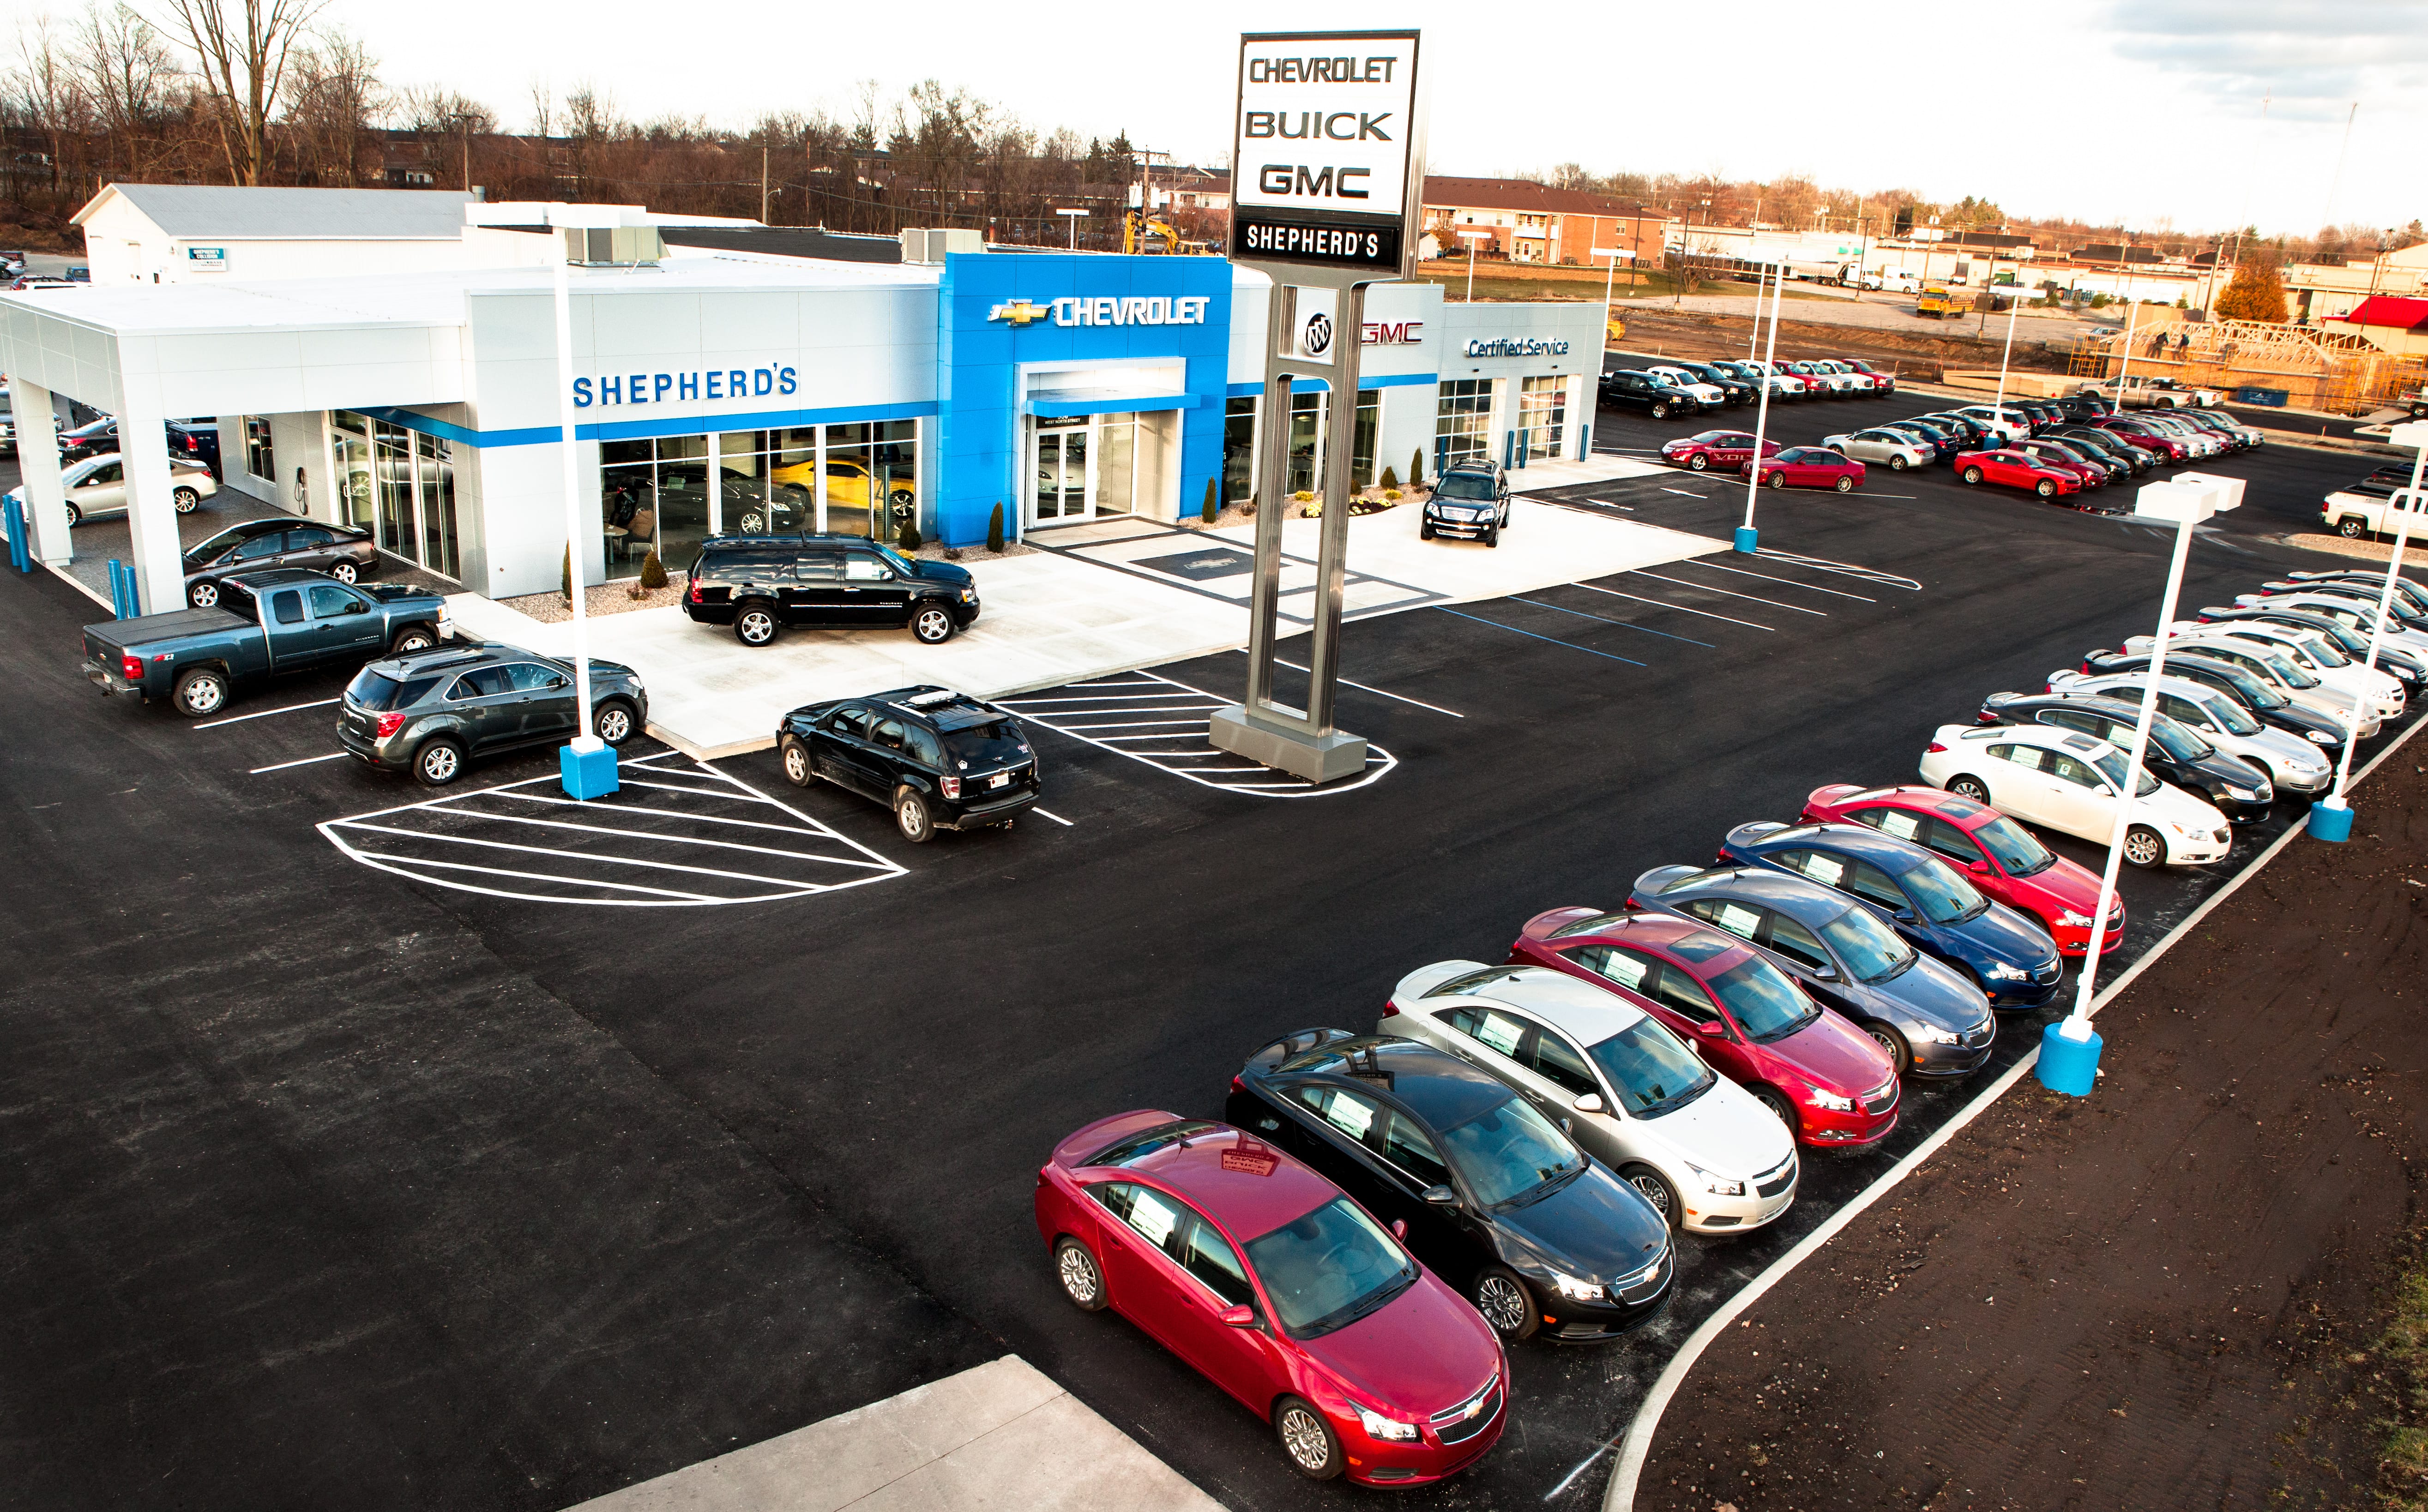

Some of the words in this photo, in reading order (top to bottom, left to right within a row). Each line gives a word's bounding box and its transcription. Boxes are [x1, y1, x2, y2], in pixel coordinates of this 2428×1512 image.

[1249, 57, 1398, 83] CHEVROLET
[1245, 112, 1393, 141] BUICK
[1259, 164, 1371, 199] GMC
[1247, 224, 1378, 258] SHEPHERD'S
[1054, 296, 1211, 326] CHEVROLET
[1361, 322, 1423, 344] GMC
[1469, 338, 1523, 358] Certified
[1526, 337, 1569, 356] Service
[573, 362, 797, 408] SHEPHERD'S
